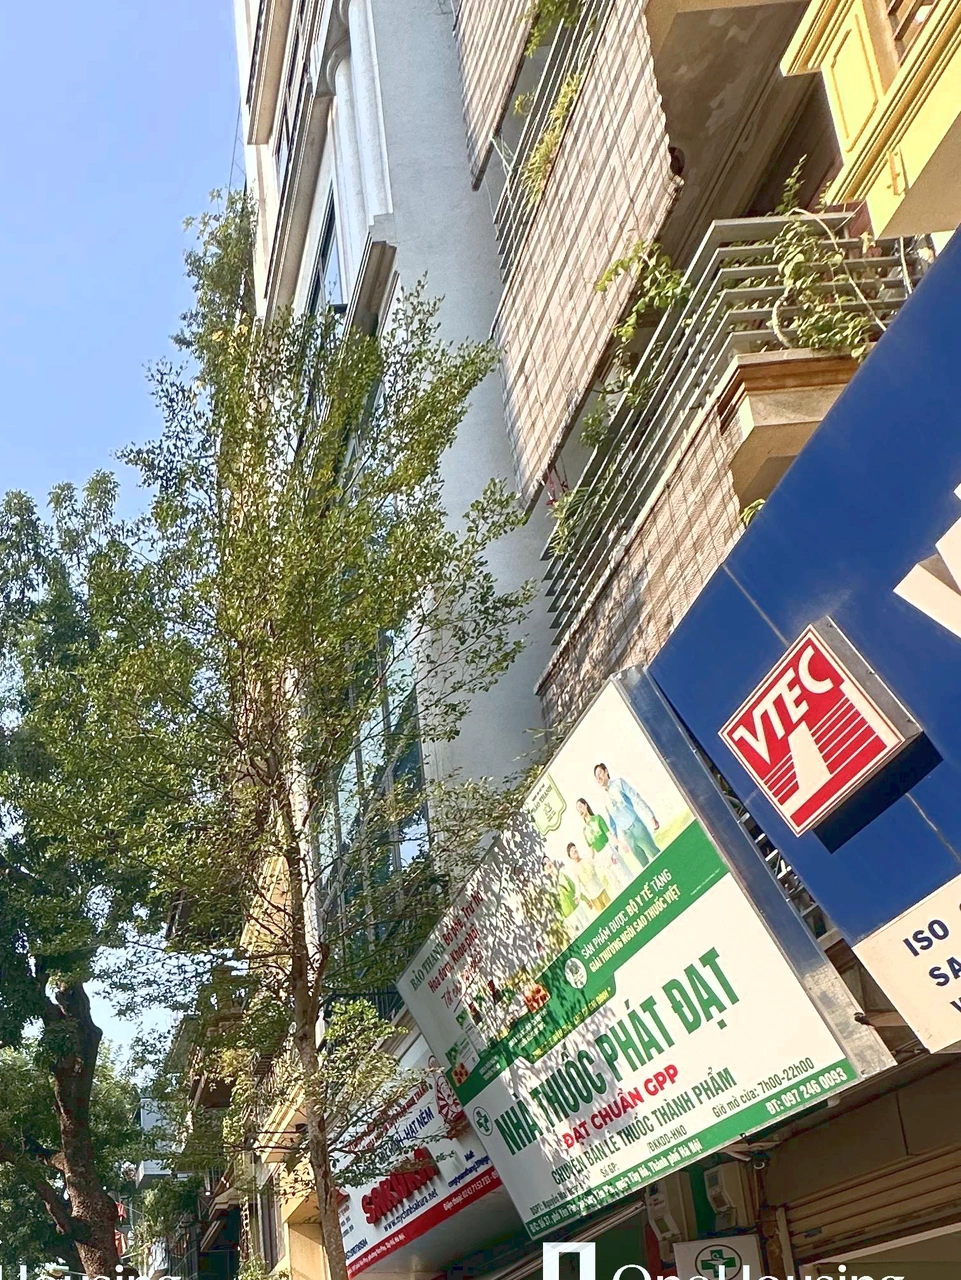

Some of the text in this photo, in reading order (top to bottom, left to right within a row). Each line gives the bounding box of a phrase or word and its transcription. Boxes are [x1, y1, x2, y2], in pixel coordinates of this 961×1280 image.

[731, 645, 834, 765] VTEC
[625, 899, 640, 917] BỘ
[634, 915, 649, 933] SAO
[644, 893, 668, 923] THUỐC
[664, 883, 681, 905] VIỆT
[636, 895, 645, 907] Y
[640, 881, 654, 902] TẾ
[581, 943, 598, 960] SẢN
[902, 919, 949, 957] ISO
[409, 969, 425, 991] BẢO
[422, 940, 447, 973] THANH
[494, 1094, 543, 1155] NHÀ
[529, 1042, 606, 1128] THUỐC
[594, 995, 675, 1082] PHÁT
[661, 946, 740, 1035] ĐẠT
[562, 1064, 679, 1149] ĐẠT CHUẨN GPP
[711, 1057, 815, 1119] Giờ mở cửa: 7h00-22h00
[766, 1067, 847, 1115] ĐT: 097 246 0093
[585, 1145, 606, 1167] BÁN
[604, 1130, 621, 1160] LẺ
[616, 1113, 655, 1148] THUỐC
[651, 1092, 696, 1127] THÀNH
[692, 1067, 738, 1105] PHẨM
[668, 1145, 682, 1166] phố
[679, 1142, 691, 1157] Hà
[690, 1138, 703, 1155] Nội
